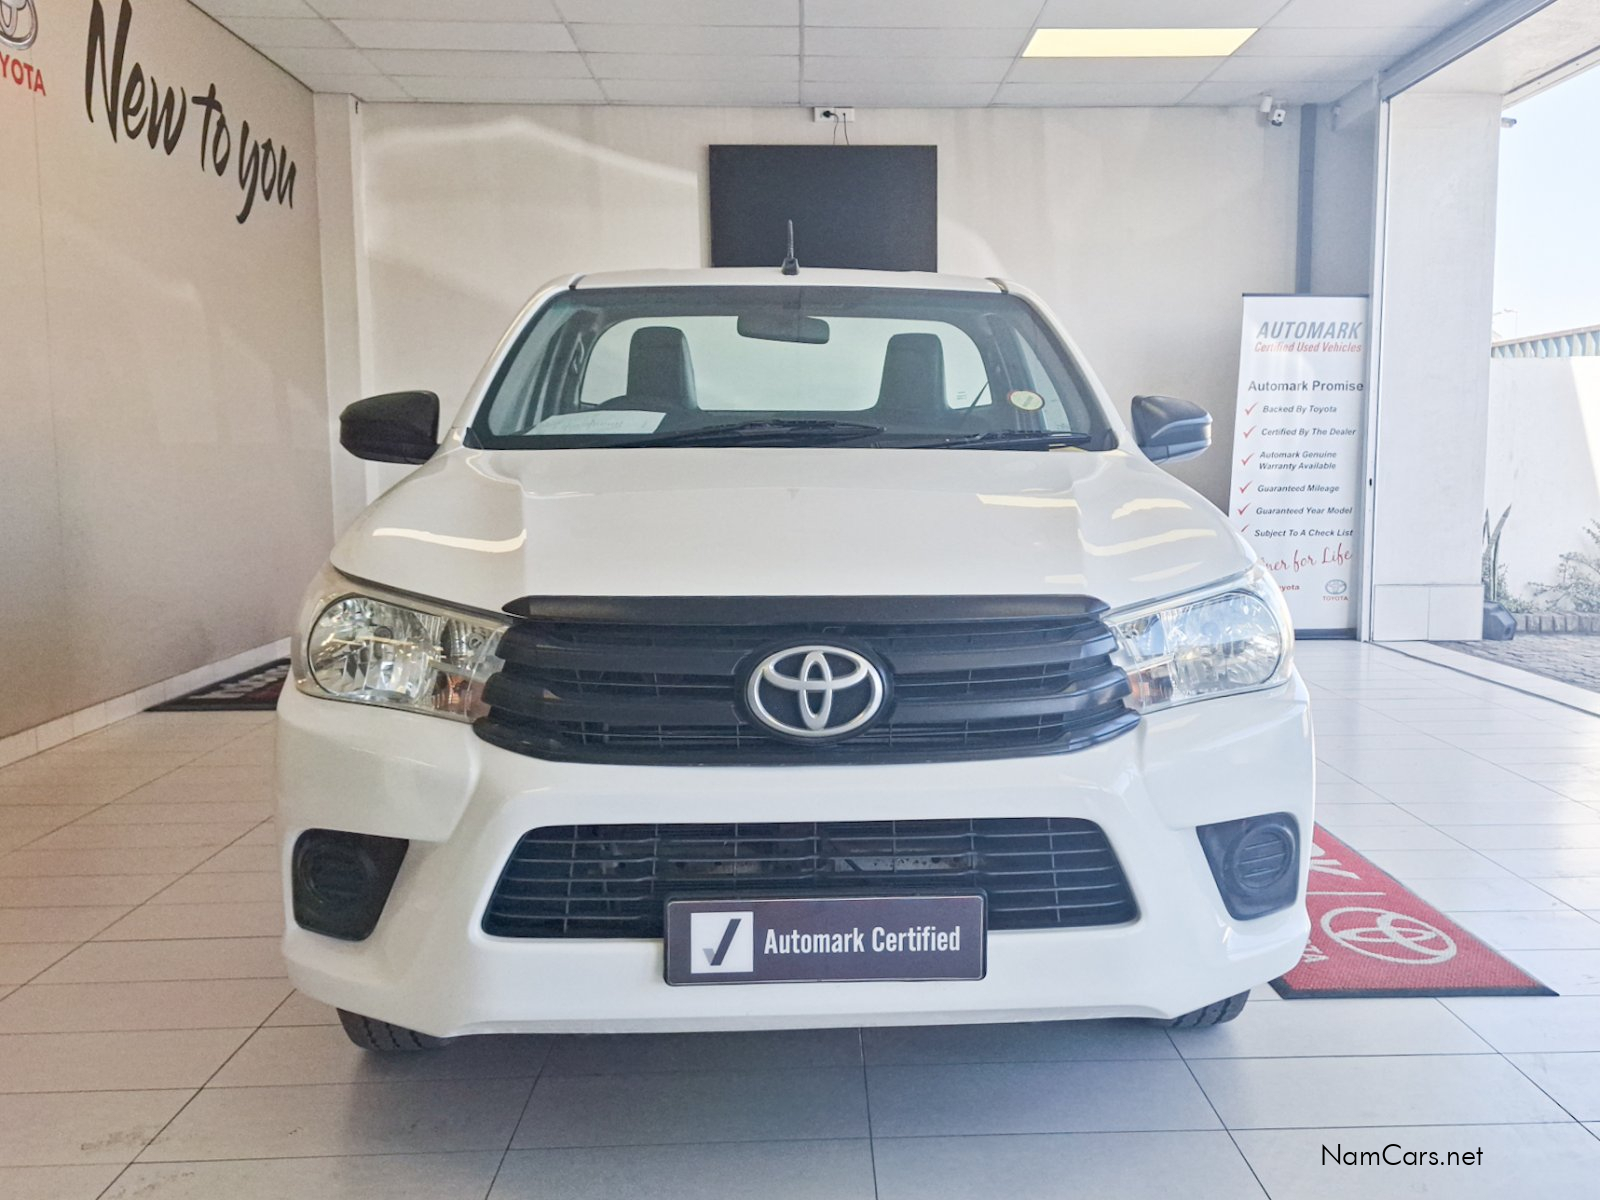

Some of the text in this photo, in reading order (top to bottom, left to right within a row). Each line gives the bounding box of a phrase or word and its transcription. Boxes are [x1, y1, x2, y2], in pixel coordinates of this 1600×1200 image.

[0, 52, 47, 97] YOTA
[85, 0, 297, 224] New to you
[1256, 321, 1363, 340] AUTOMARK
[1254, 341, 1362, 353] Certified Used Vehicles
[1247, 380, 1364, 392] Automark Promise
[1262, 405, 1337, 415] Backed By Toyota
[1261, 428, 1356, 438] Certified By The Dealer
[1259, 450, 1337, 459] Automark Genuine
[1259, 462, 1337, 471] Warranty Available
[1257, 484, 1340, 494] Guaranteed Mileage
[1256, 507, 1353, 515] Guaranteed Year Model
[1254, 528, 1353, 539] Subject To A Check List
[1293, 549, 1317, 572] for
[1322, 542, 1353, 566] Life
[1279, 584, 1300, 592] yota
[763, 926, 961, 955] Automark Certified
